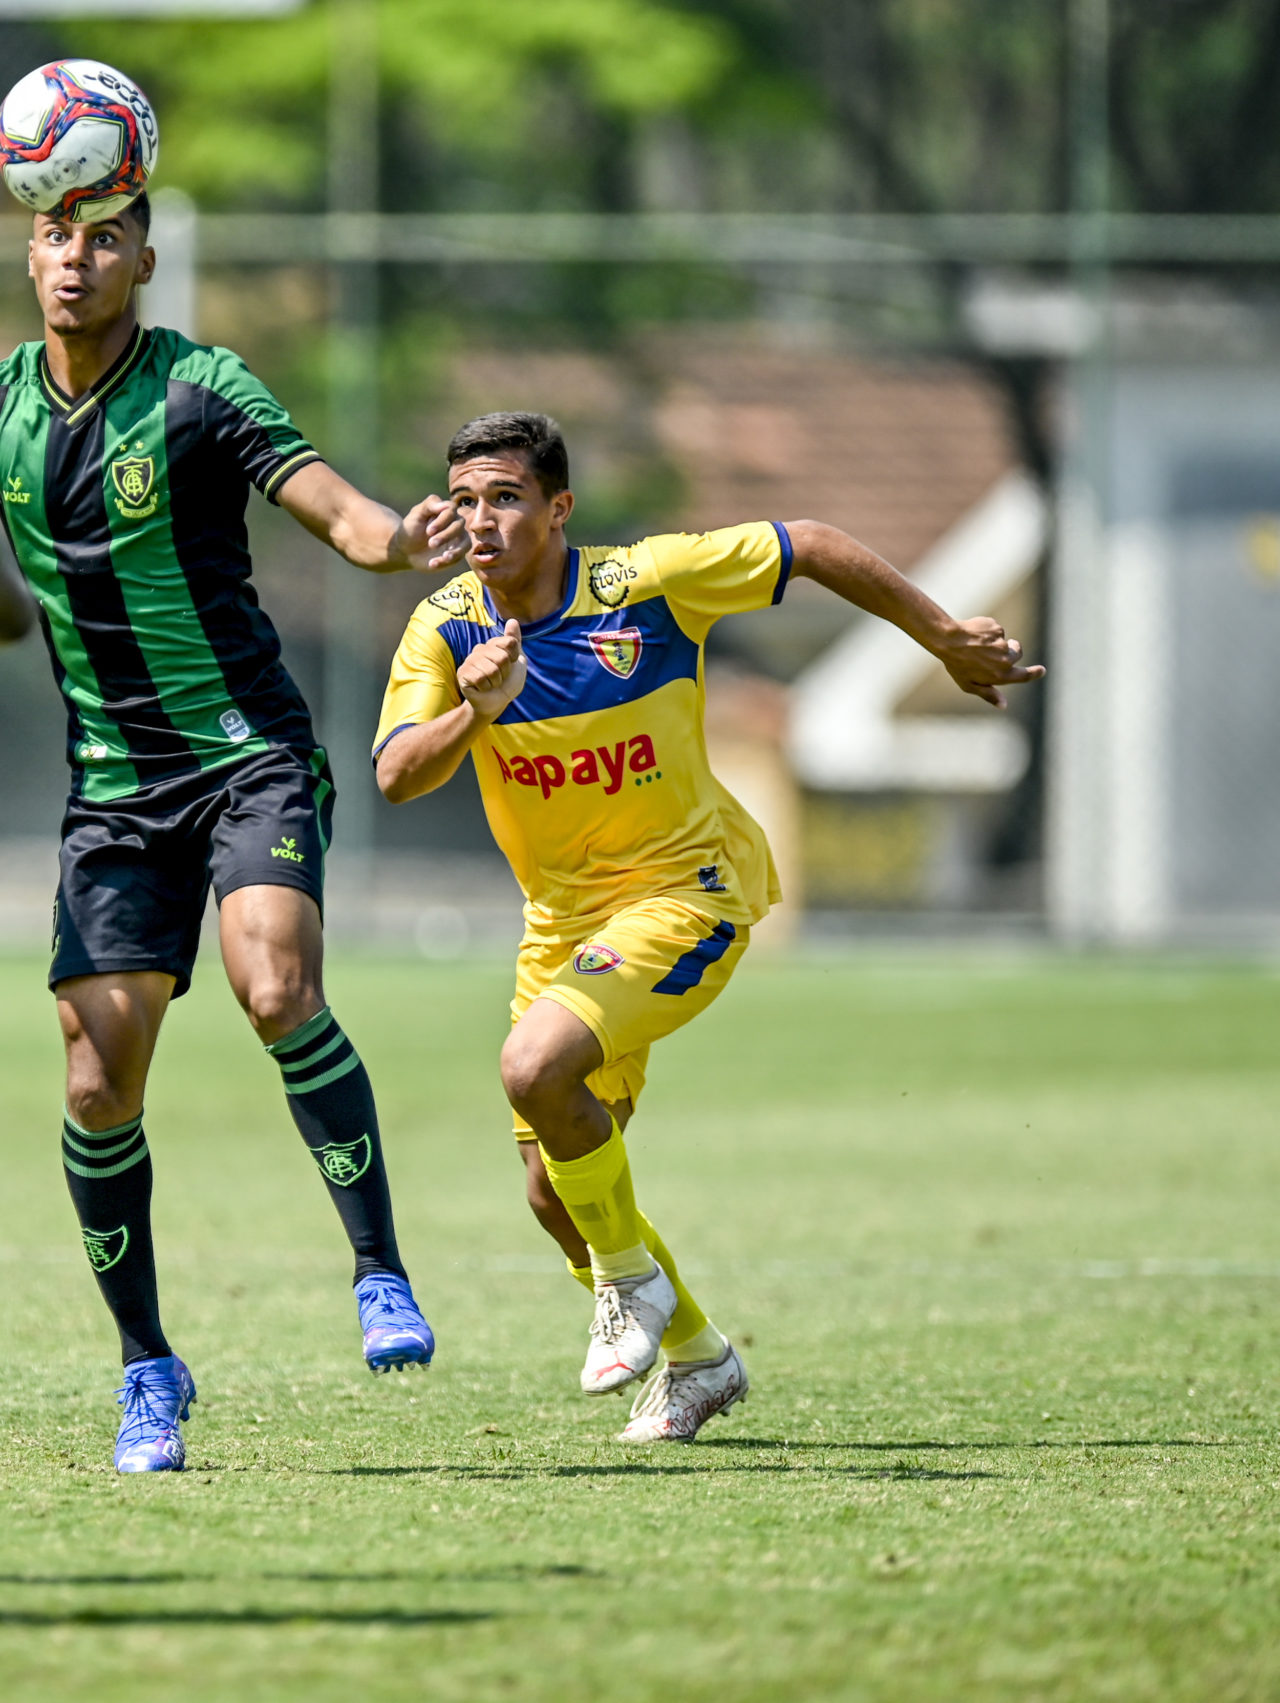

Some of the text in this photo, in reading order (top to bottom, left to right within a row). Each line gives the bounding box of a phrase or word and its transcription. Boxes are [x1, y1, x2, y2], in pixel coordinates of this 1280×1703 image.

[3, 491, 31, 504] VOLT
[593, 566, 638, 590] CLOVIS
[270, 847, 305, 863] VOLT
